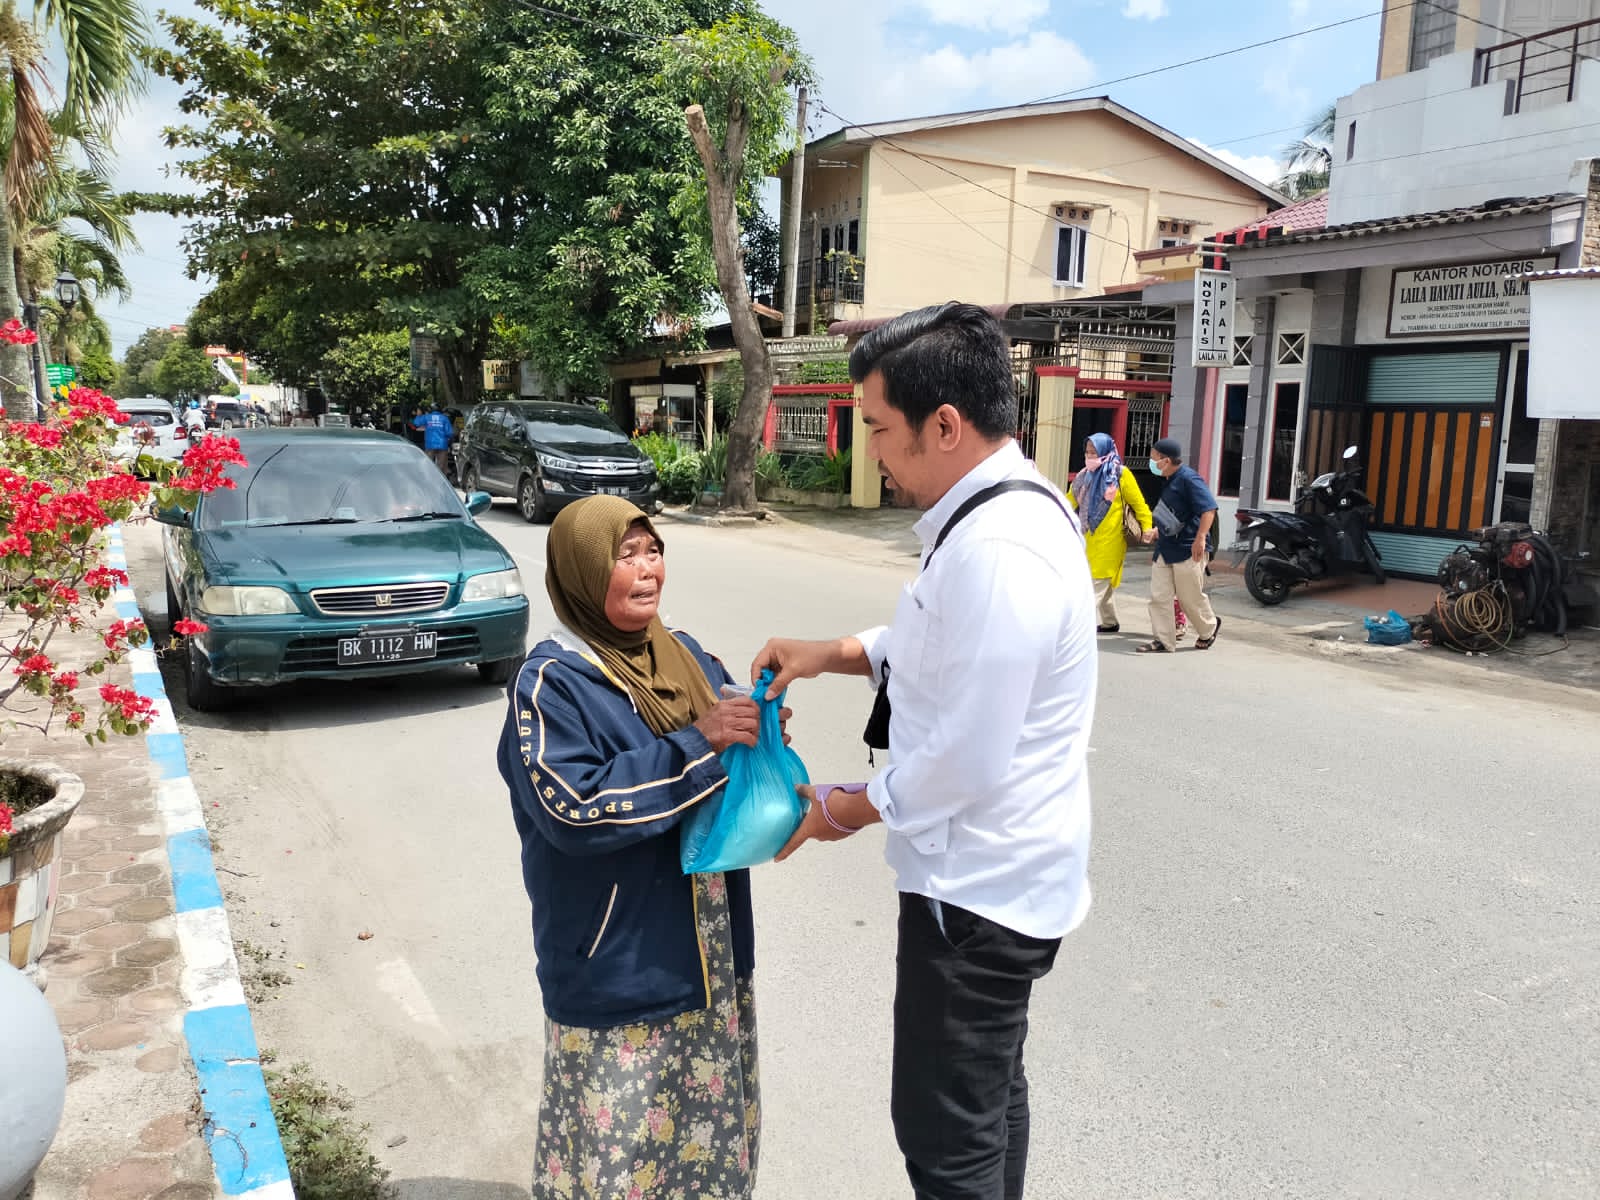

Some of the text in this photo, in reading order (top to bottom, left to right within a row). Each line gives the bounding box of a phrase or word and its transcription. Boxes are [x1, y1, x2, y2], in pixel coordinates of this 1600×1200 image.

[1413, 261, 1535, 282] KANTOR NOTARIS
[1400, 286, 1427, 304] LAILA
[1429, 283, 1465, 302] HAYATI
[1466, 281, 1500, 300] AULIA,
[1201, 280, 1212, 345] NOTARIS
[1218, 282, 1228, 345] PPAT
[1199, 352, 1215, 361] LAILA
[343, 634, 433, 656] BK 1112 HW
[543, 786, 634, 820] SPORTS
